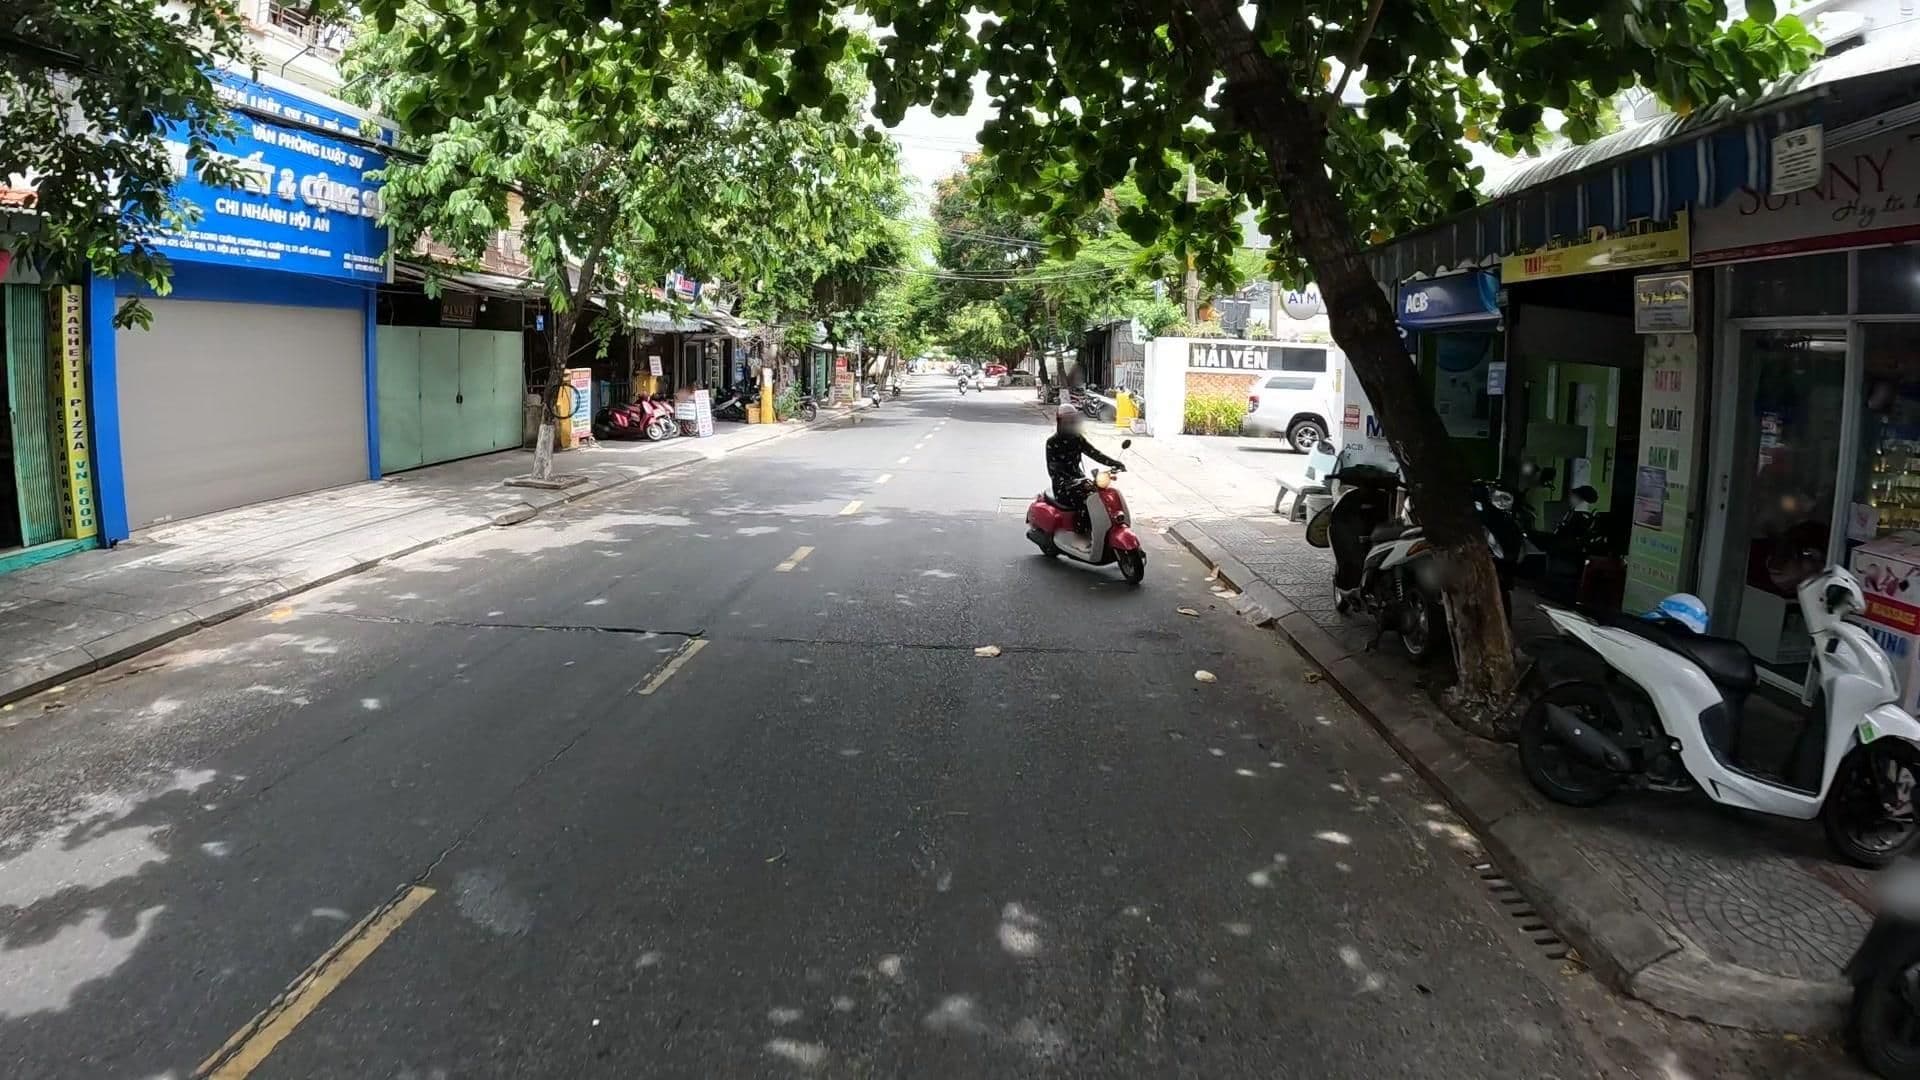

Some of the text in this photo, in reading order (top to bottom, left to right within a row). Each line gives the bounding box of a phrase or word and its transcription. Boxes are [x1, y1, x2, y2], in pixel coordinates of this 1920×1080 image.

[252, 123, 364, 169] VĂN PHÒNG LUẬT SƯ
[300, 171, 360, 214] CỘNG
[215, 198, 331, 233] CHI NHÁNH HỘI AN
[1287, 292, 1318, 305] ATM
[1405, 291, 1429, 313] ACB
[67, 294, 80, 389] SPAGHETTI
[70, 398, 85, 450] PIZZA
[78, 485, 93, 527] FOOD
